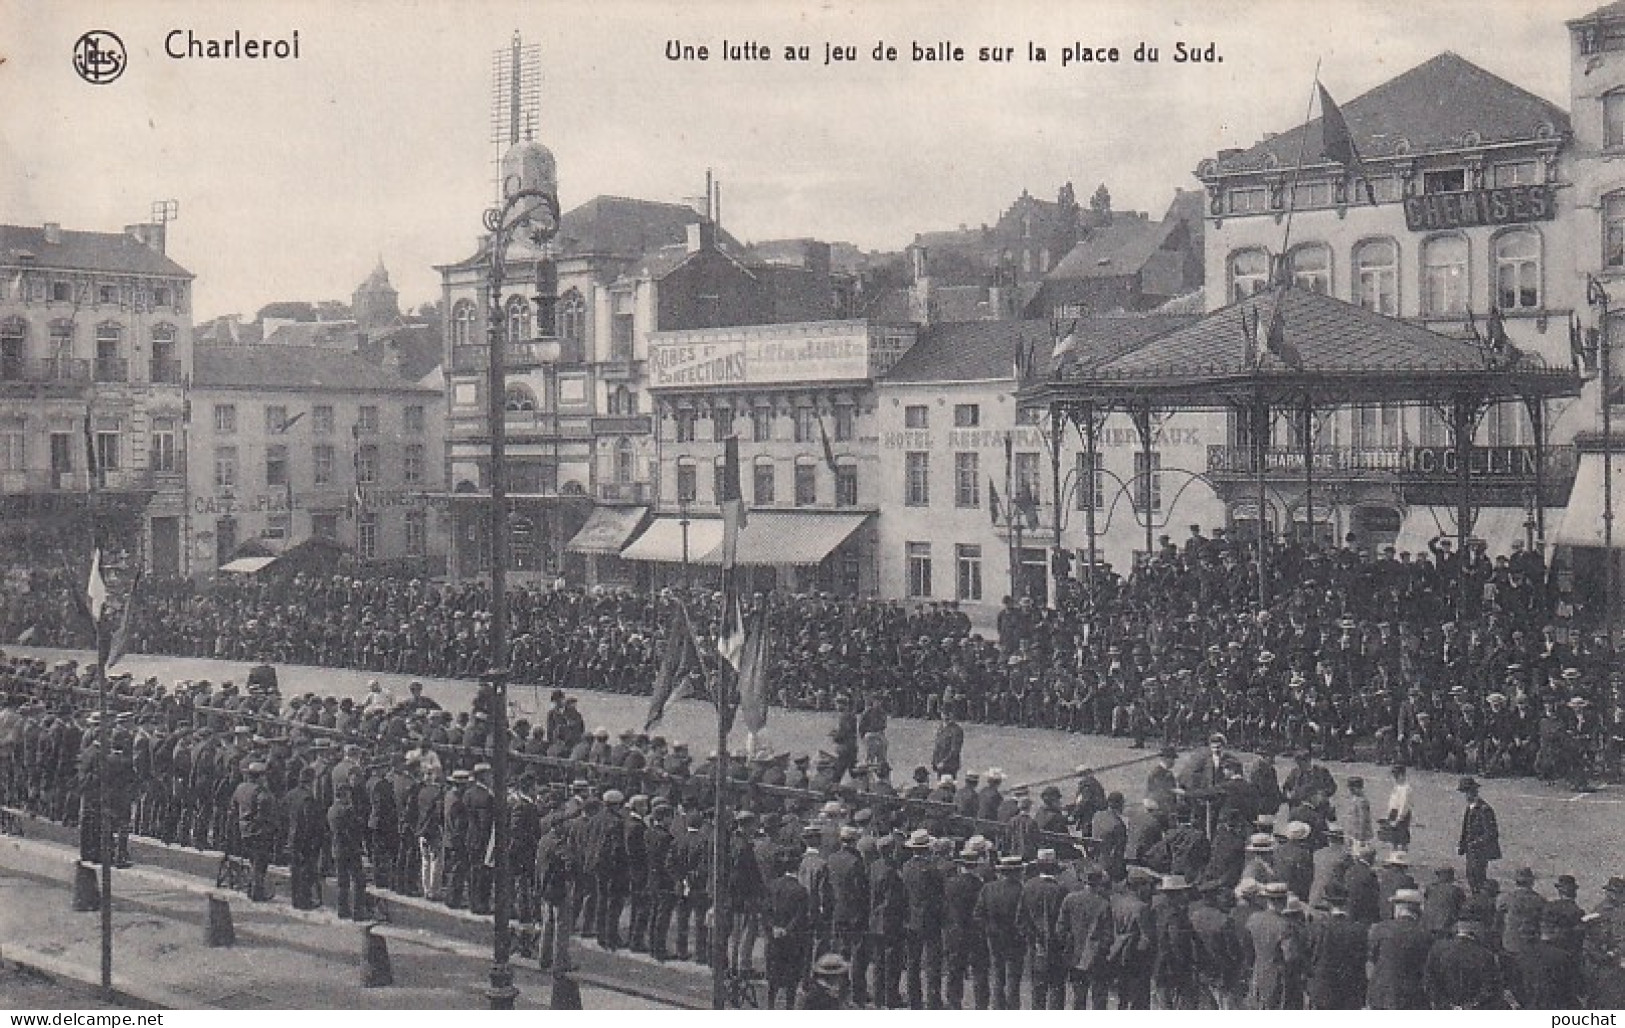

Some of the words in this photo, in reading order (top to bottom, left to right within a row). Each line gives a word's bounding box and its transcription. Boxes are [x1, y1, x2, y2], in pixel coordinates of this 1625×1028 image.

[1406, 187, 1547, 227] CHEMISES
[648, 344, 695, 373] ROBES
[658, 351, 746, 383] CONFECTIONS
[948, 429, 1063, 448] RESTAURA
